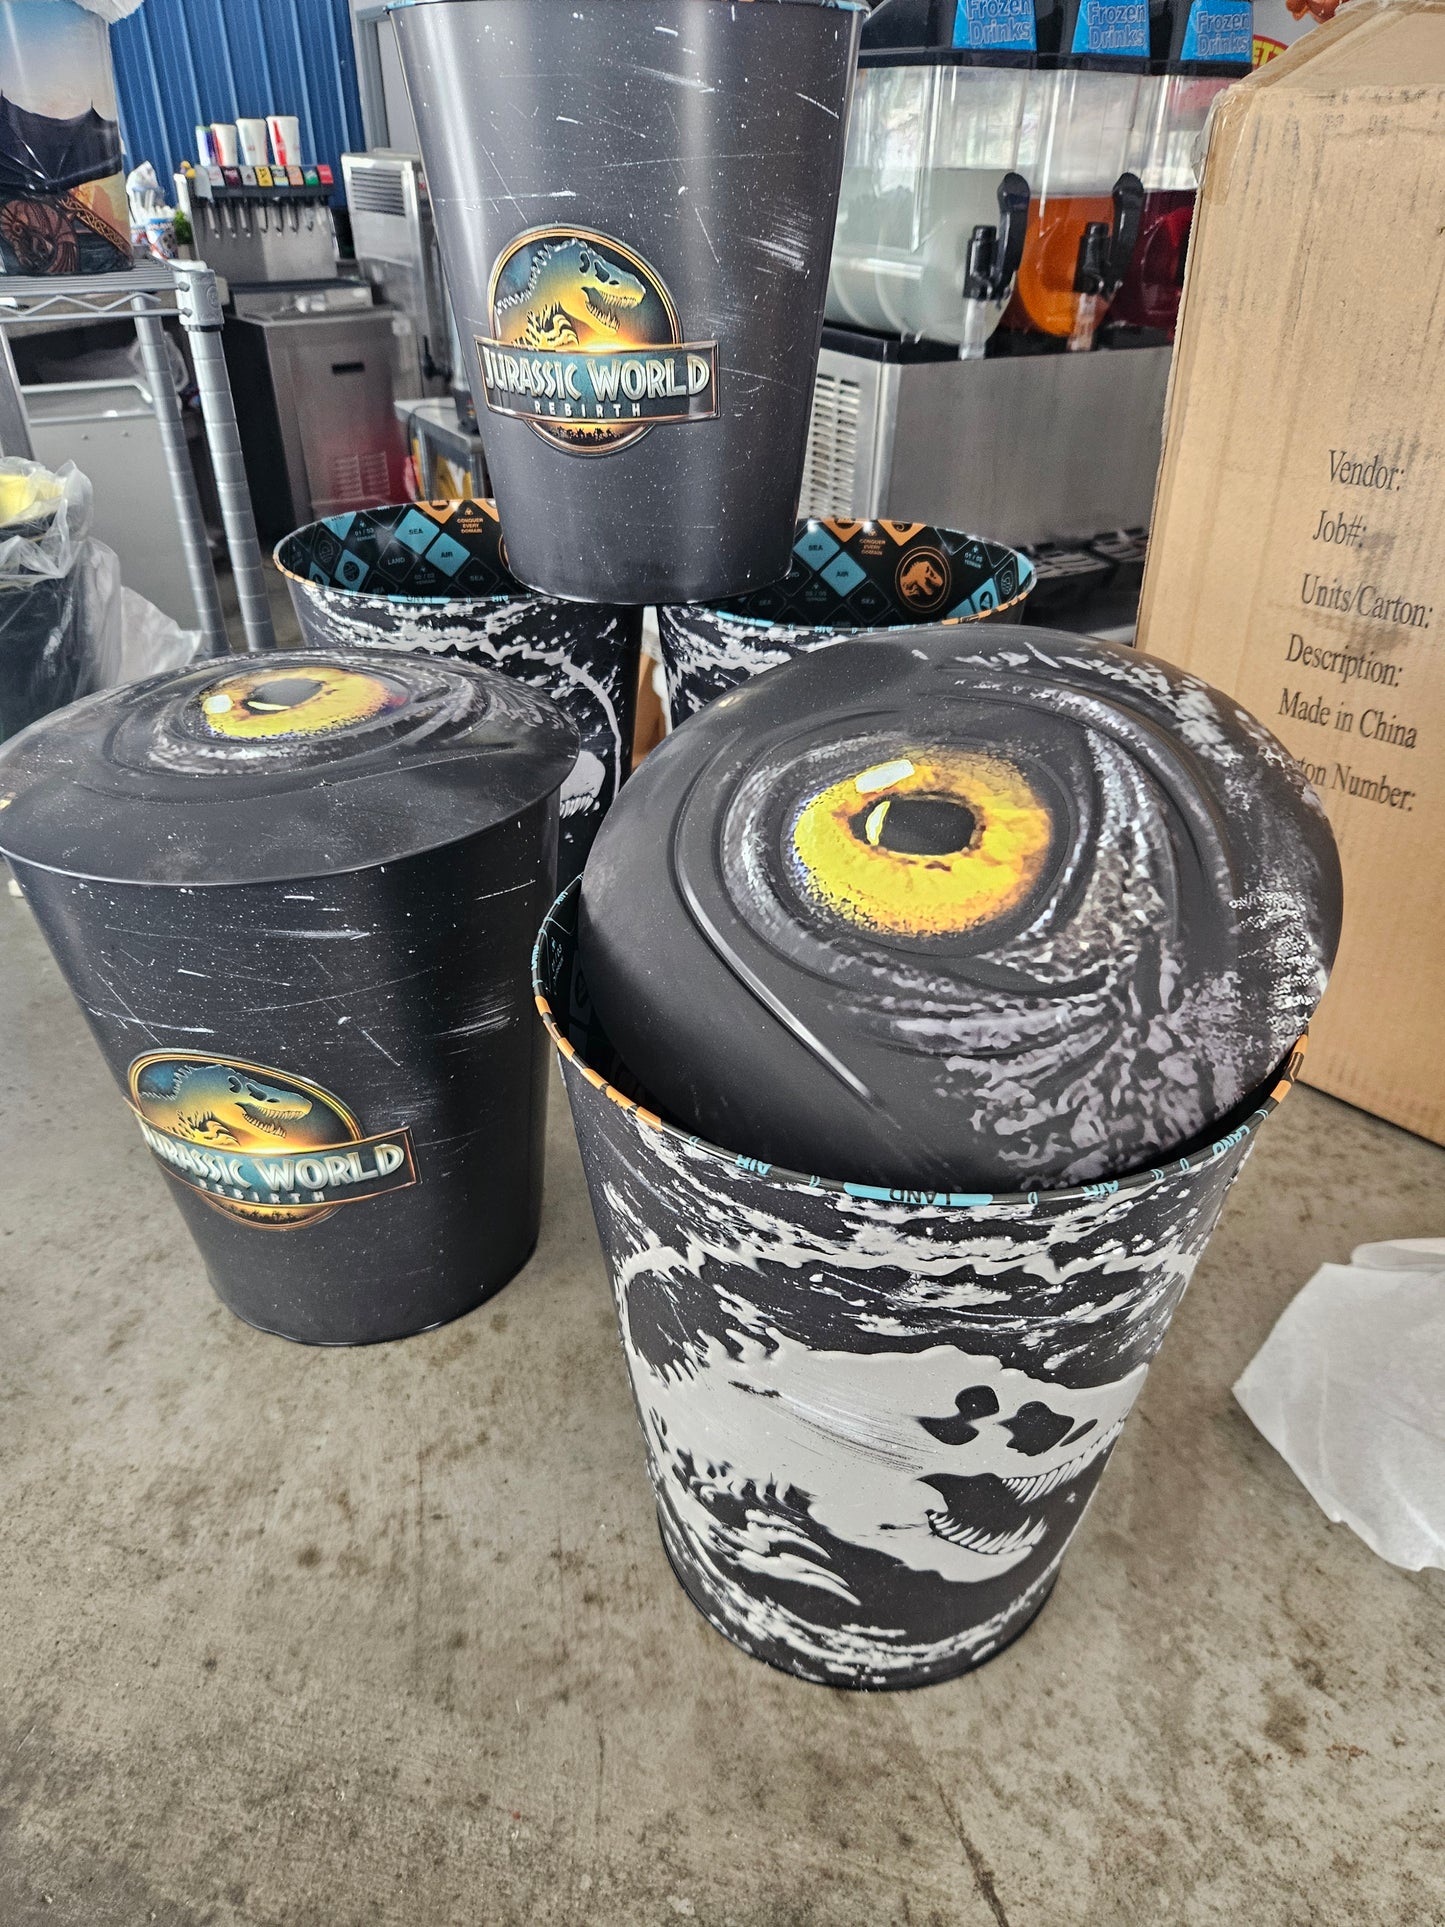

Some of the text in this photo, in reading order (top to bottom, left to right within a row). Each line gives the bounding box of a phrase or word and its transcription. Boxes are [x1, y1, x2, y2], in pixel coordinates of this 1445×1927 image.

[966, 0, 1032, 20] Frozen
[1087, 1, 1146, 26] Frozen
[1196, 10, 1250, 34] Frozen
[969, 17, 1032, 45] Drinks
[1089, 24, 1145, 49] Drinks
[1197, 32, 1249, 56] Drinks
[482, 346, 710, 401] JURASSIC WORLD
[534, 401, 641, 418] REBIRTH
[1328, 449, 1404, 491] Vendor:
[408, 527, 424, 536] SEA
[1312, 510, 1367, 548] Job#:
[387, 557, 406, 566] LAND
[1301, 573, 1433, 628] Units/Carton:
[1285, 633, 1403, 687] Description:
[1278, 687, 1417, 749] Made in China
[1297, 756, 1416, 811] ton Number:
[137, 1120, 405, 1192] JURASSIC WORLD
[735, 1154, 772, 1175] AIR
[198, 1178, 325, 1204] REBIRTH
